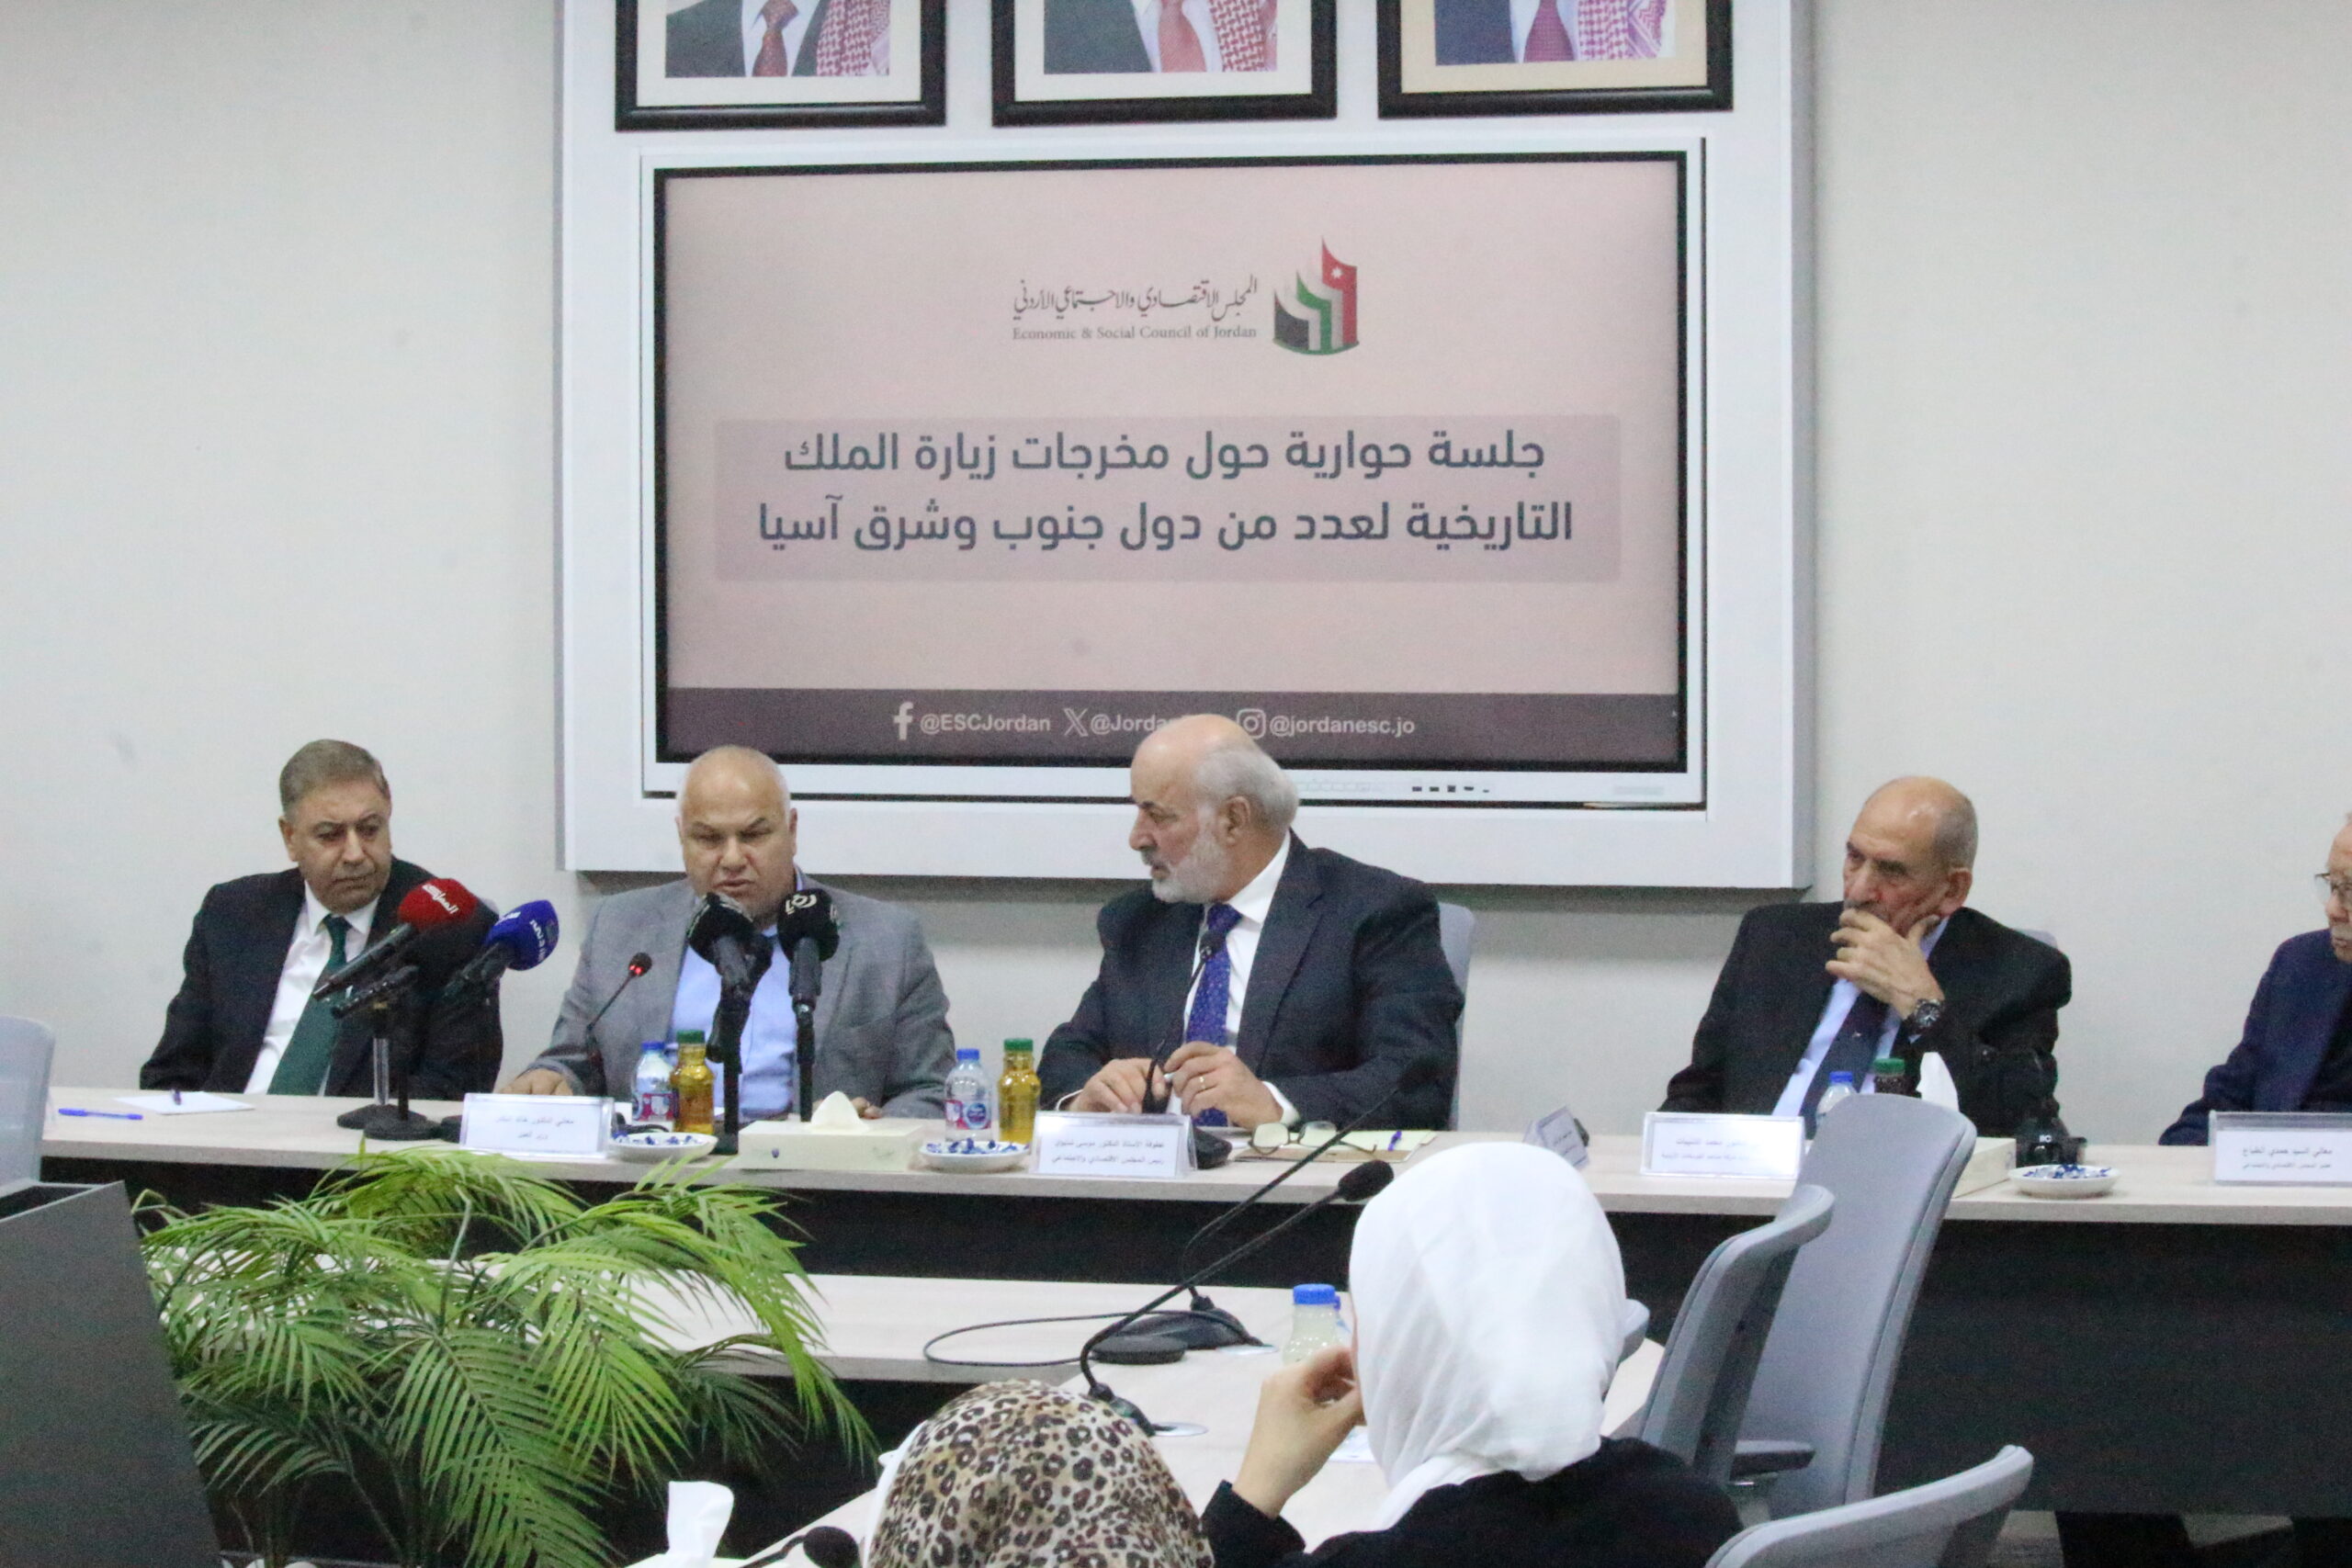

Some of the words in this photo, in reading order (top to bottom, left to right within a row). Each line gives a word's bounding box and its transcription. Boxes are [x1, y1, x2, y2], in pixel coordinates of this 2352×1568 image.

[1012, 327, 1076, 340] Economic
[1081, 327, 1092, 339] &
[1097, 325, 1136, 339] Social
[1139, 325, 1192, 339] Council
[1196, 325, 1211, 338] of
[1214, 325, 1257, 339] Jordan
[785, 432, 899, 471] الملك
[914, 432, 996, 481] زيارة
[1012, 431, 1170, 480] مخرجات
[1185, 430, 1270, 480] حول
[1285, 430, 1412, 479] حوارية
[1428, 429, 1544, 479] جلسة
[760, 493, 843, 551] آسيا
[854, 498, 977, 551] وشرق
[993, 505, 1104, 551] جنوب
[1120, 502, 1202, 551] دول
[1217, 512, 1277, 551] من
[1294, 501, 1389, 540] لعدد
[1406, 501, 1572, 551] التاريخية
[920, 713, 1051, 736] @ESCJordan
[1269, 714, 1416, 739] @jordanesc.jo
